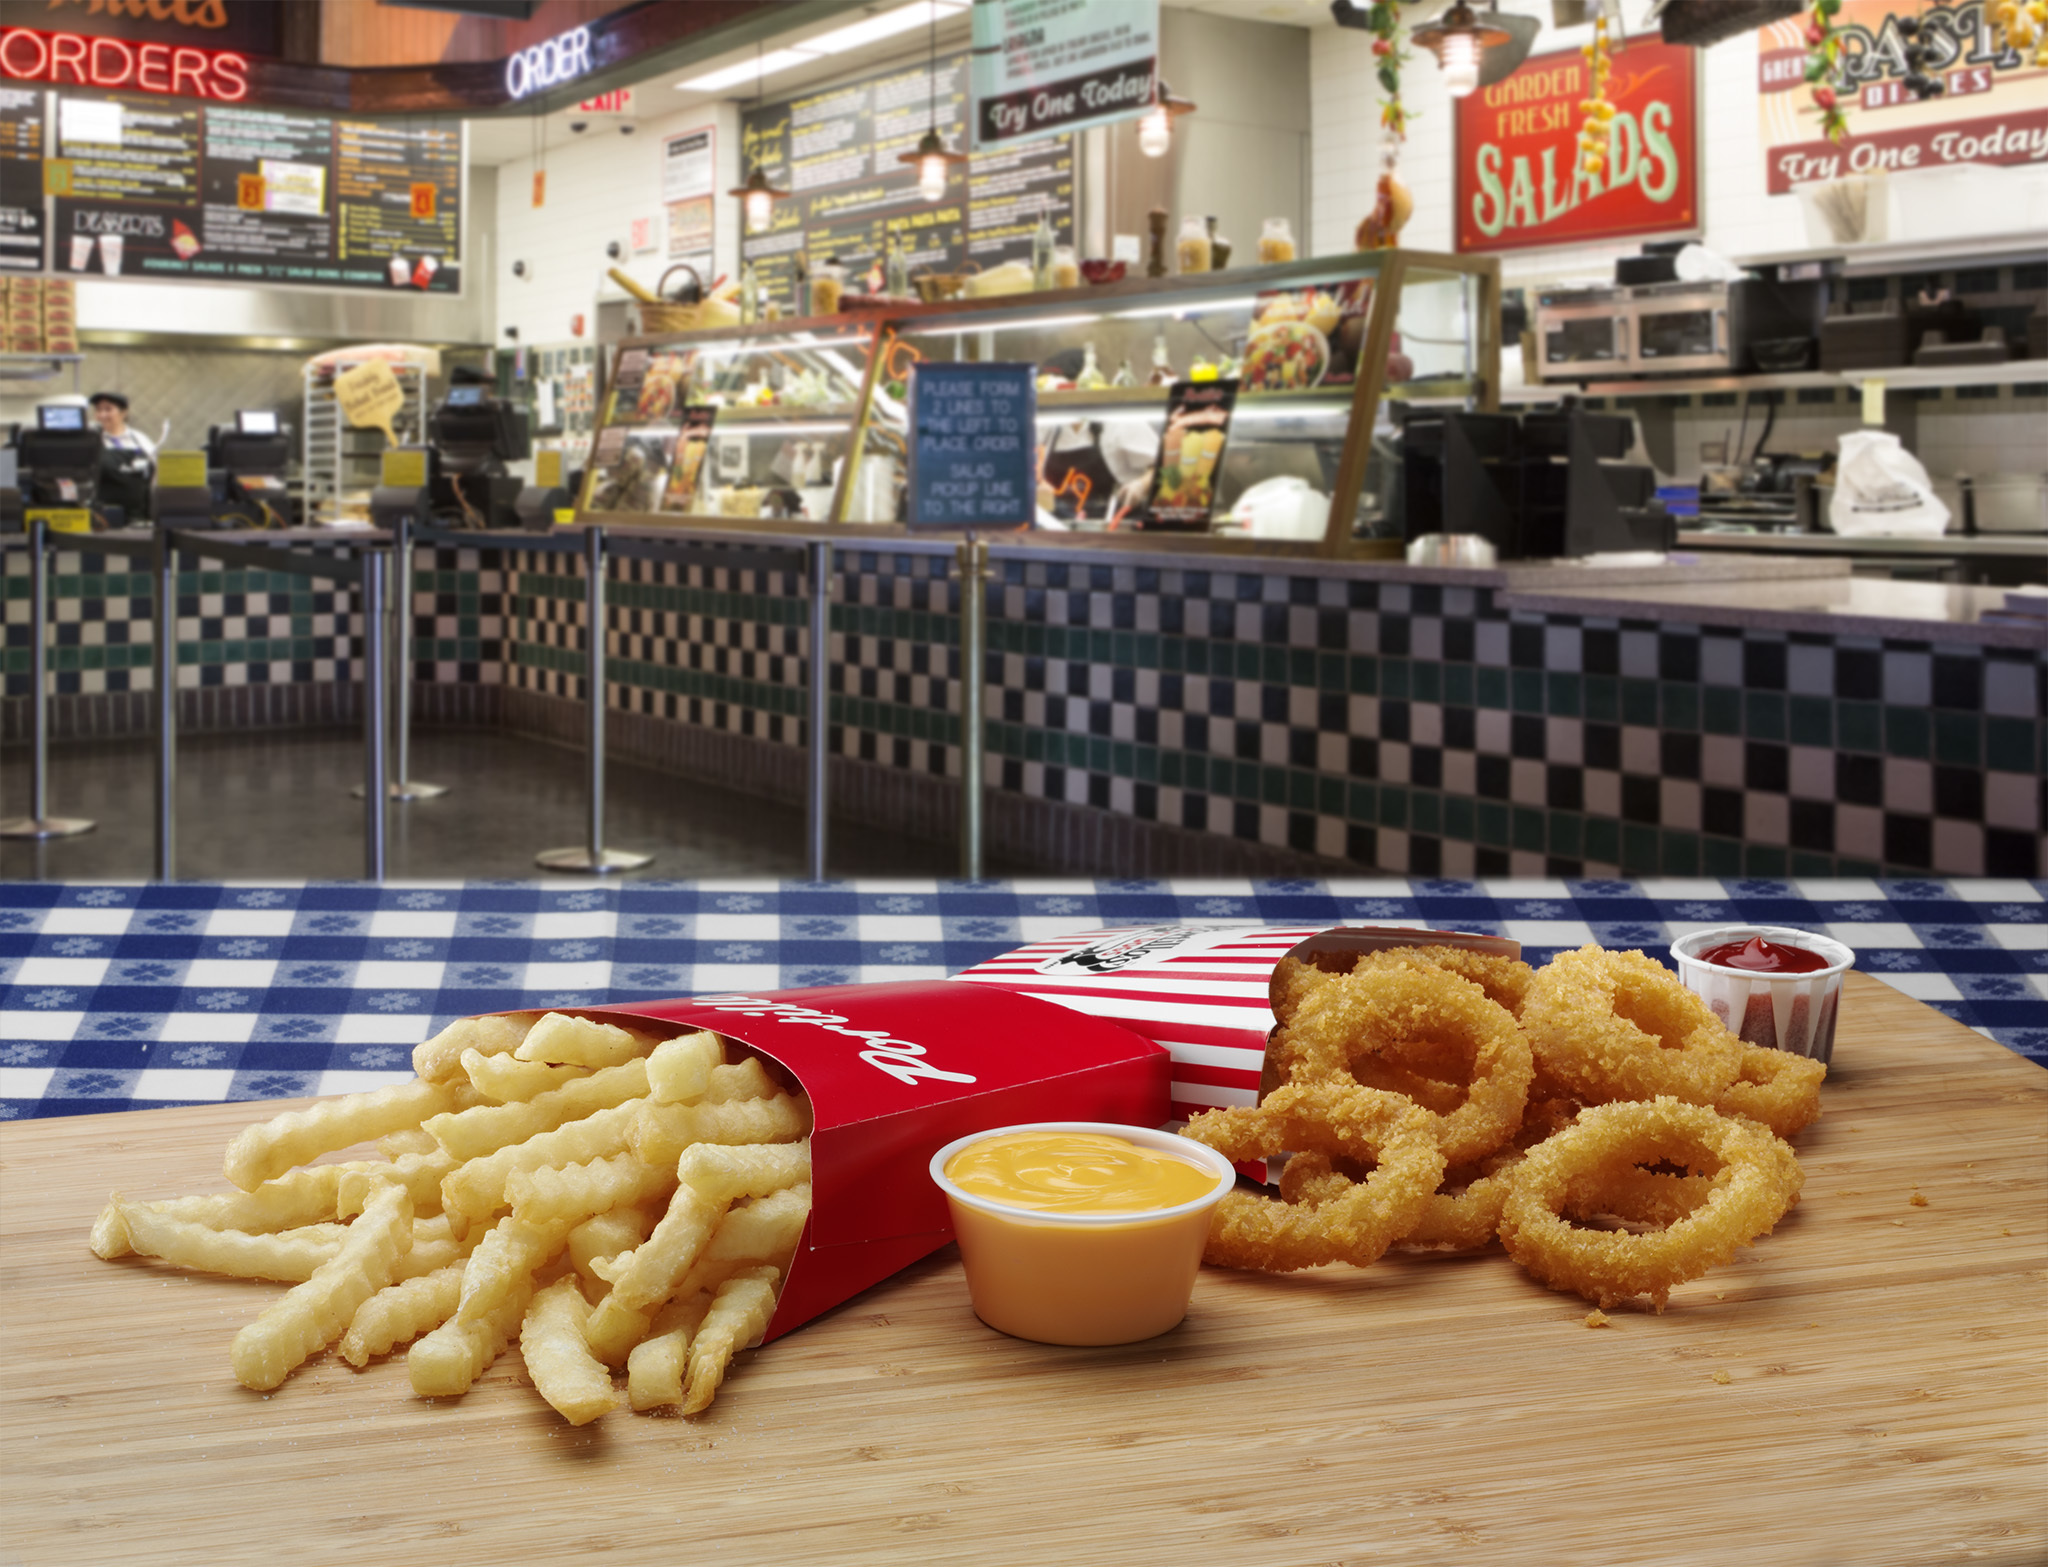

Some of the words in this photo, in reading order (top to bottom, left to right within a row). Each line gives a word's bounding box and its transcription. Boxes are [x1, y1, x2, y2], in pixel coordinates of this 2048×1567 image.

[0, 28, 248, 100] ORDERS
[506, 26, 591, 98] ORDER
[1828, 0, 2024, 96] PAST
[1485, 65, 1580, 108] GARDEN
[1762, 55, 1810, 83] GREA
[989, 103, 1028, 132] Try
[1033, 93, 1076, 121] One
[1081, 73, 1151, 109] Today
[1866, 68, 1988, 108] DIES
[1497, 102, 1570, 138] FRESH
[1473, 100, 1678, 237] SALADS
[1779, 153, 1840, 181] Try
[1850, 143, 1920, 173] One
[1931, 124, 2048, 162] Today
[922, 380, 974, 396] PLEASE
[980, 380, 1020, 396] FORM
[927, 417, 951, 433] THE
[958, 417, 991, 433] LEFT
[999, 418, 1018, 433] TO
[948, 399, 984, 415] LINES
[991, 400, 1011, 414] TO
[923, 436, 967, 451] PLACE
[974, 436, 1019, 451] ORDER
[931, 481, 979, 497] PICKUP
[984, 481, 1012, 497] LINE
[951, 463, 995, 479] SALAD
[924, 500, 943, 516] TO
[951, 500, 975, 516] THE
[982, 499, 1020, 515] RIGHT
